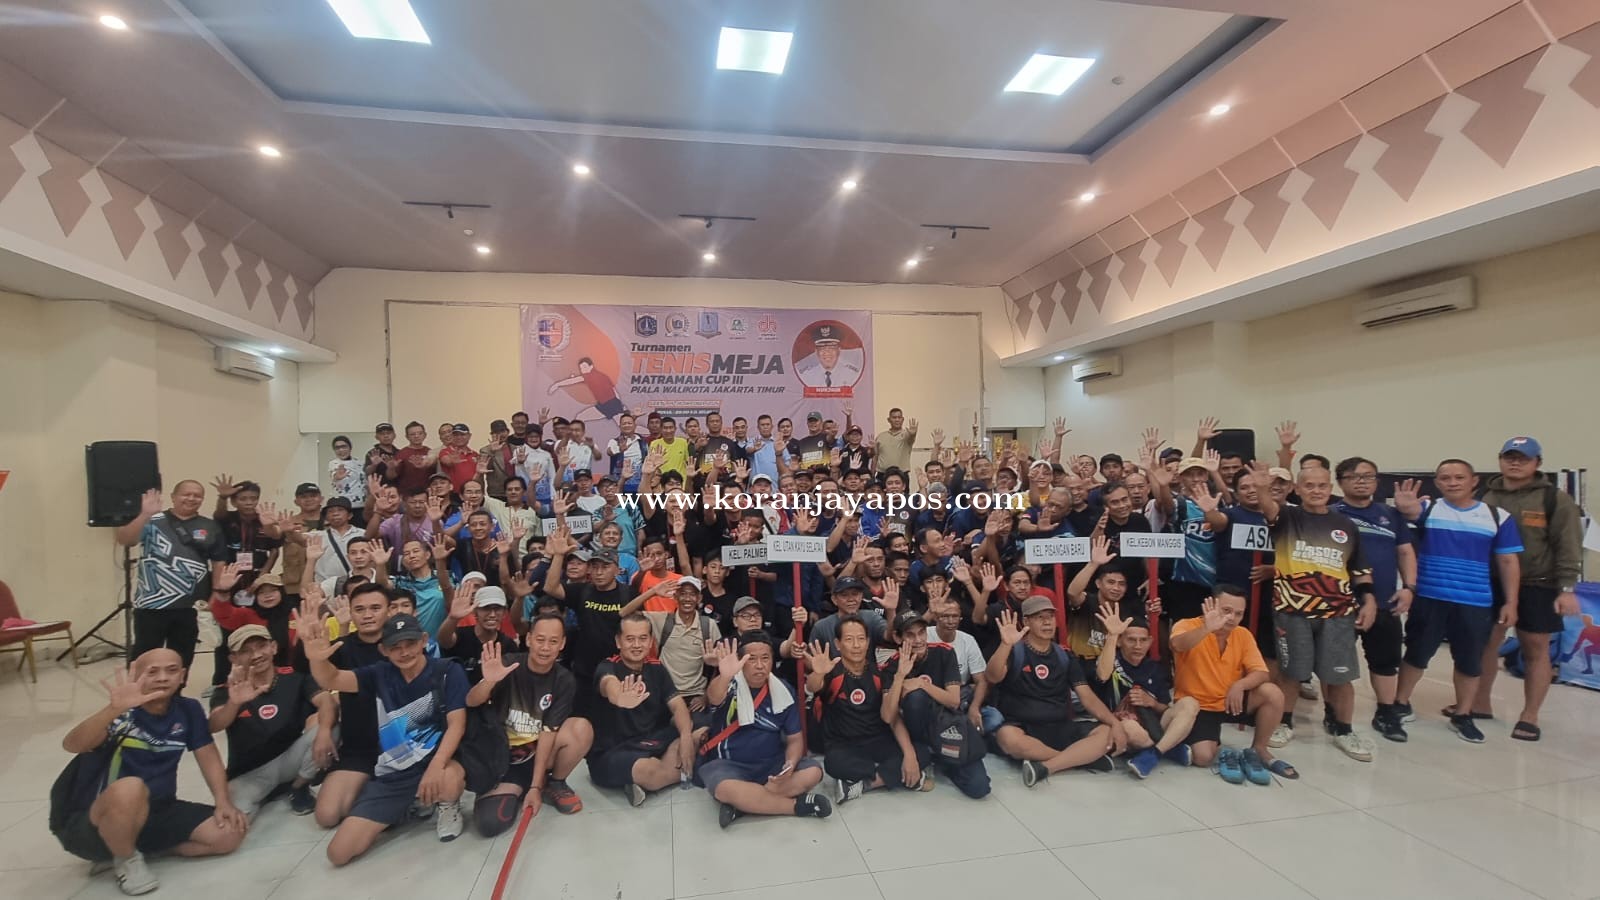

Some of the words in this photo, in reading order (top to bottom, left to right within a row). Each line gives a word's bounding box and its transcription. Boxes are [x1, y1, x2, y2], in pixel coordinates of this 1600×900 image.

[631, 342, 691, 351] Turnamen
[630, 352, 710, 374] TENIS
[711, 354, 784, 374] MEJA
[630, 375, 702, 385] MATRAMAN
[705, 375, 730, 385] CUP
[732, 375, 744, 384] III
[630, 386, 660, 394] PIALA
[662, 386, 709, 394] WALIKOTA
[711, 386, 754, 394] JAKARTA
[757, 386, 785, 394] TIMUR
[744, 547, 768, 559] PALMER
[584, 600, 621, 612] OFFICIAL
